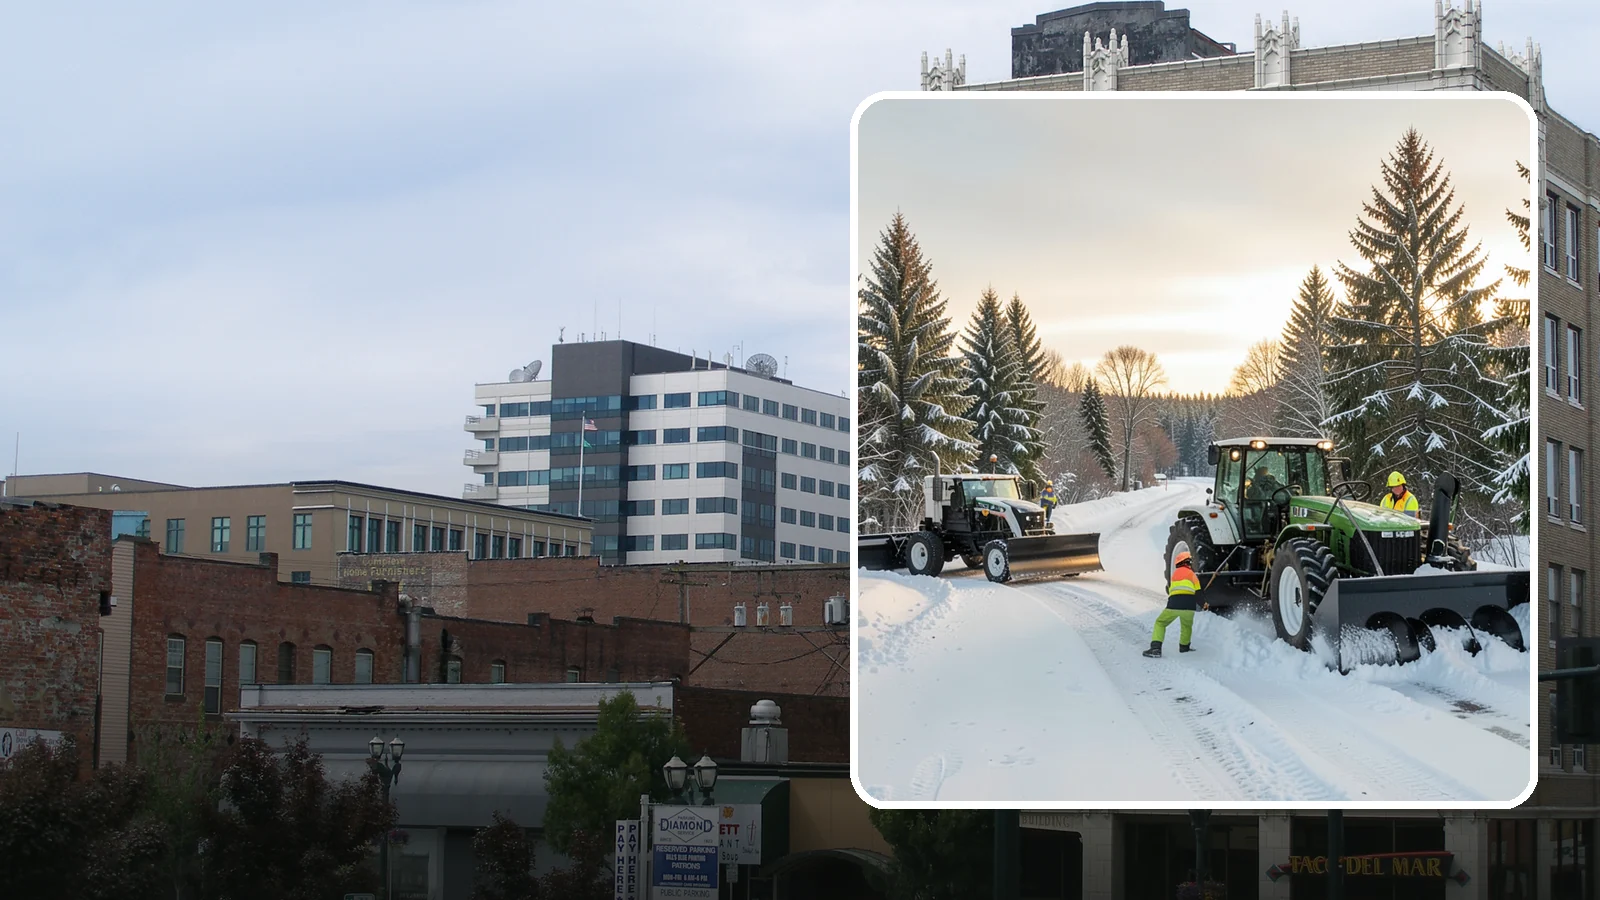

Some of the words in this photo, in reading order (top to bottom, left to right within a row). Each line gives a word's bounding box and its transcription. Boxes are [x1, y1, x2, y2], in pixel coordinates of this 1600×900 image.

[370, 566, 427, 577] Furnishers
[660, 818, 713, 833] DIAMOND
[1022, 815, 1070, 827] BUILDING
[617, 825, 625, 852] PAY
[628, 824, 637, 852] PAY
[655, 845, 688, 853] RESERVED
[689, 846, 716, 854] PARKING
[671, 862, 701, 870] PATRONS
[1346, 856, 1385, 875] DEL
[1392, 857, 1442, 877] MAR
[616, 856, 625, 893] HERE
[627, 855, 636, 893] HERE
[660, 888, 682, 897] PUBLIC
[683, 889, 710, 898] PARKING
